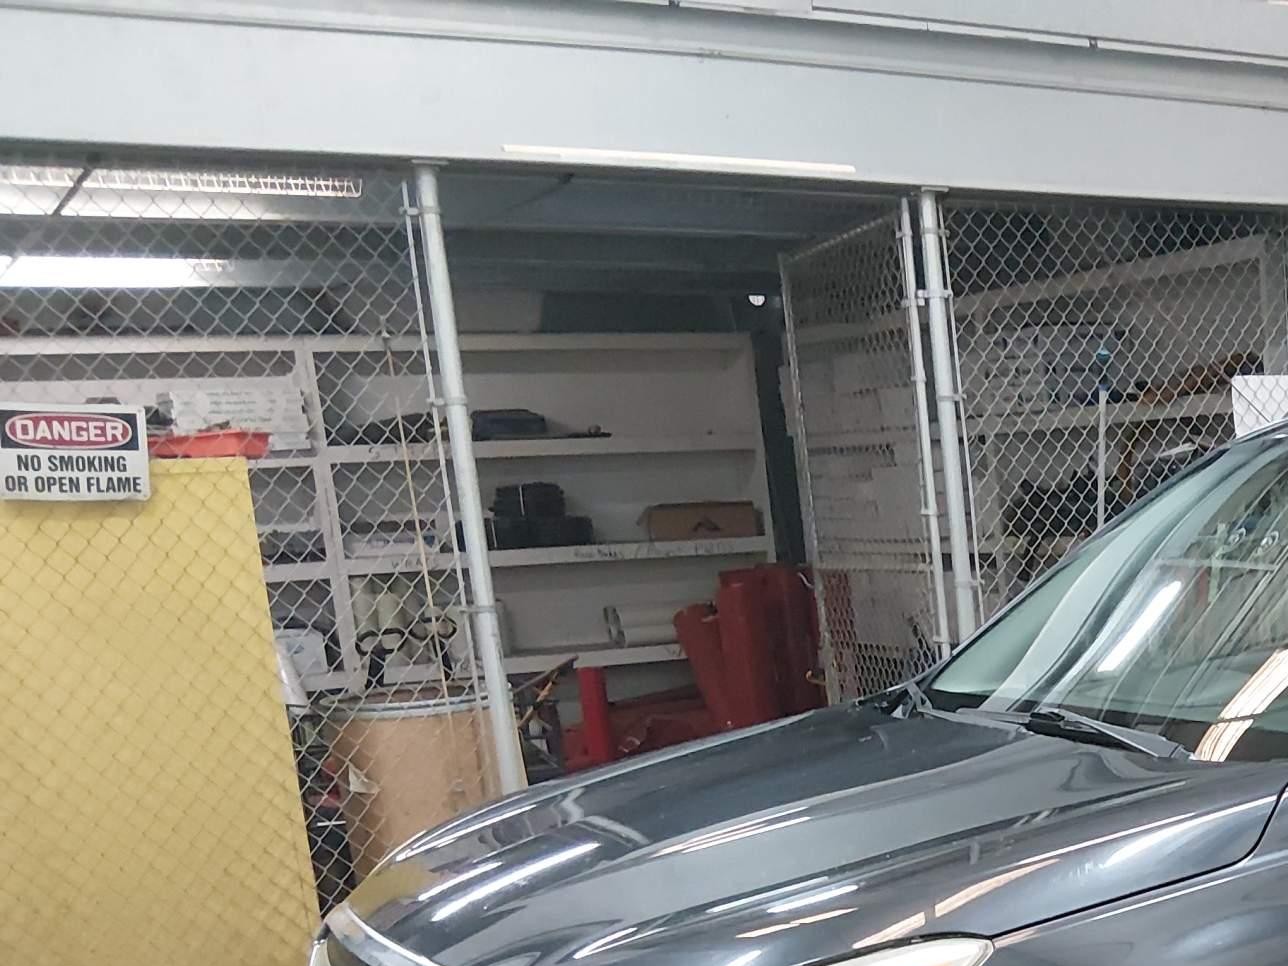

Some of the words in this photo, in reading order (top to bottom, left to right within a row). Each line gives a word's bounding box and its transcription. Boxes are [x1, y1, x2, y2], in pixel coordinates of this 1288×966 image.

[15, 419, 124, 442] DANGER
[16, 454, 42, 472] NO
[48, 455, 127, 473] SMOKING
[5, 475, 28, 493] OR
[34, 476, 80, 493] OPEN
[87, 476, 142, 494] FLAME
